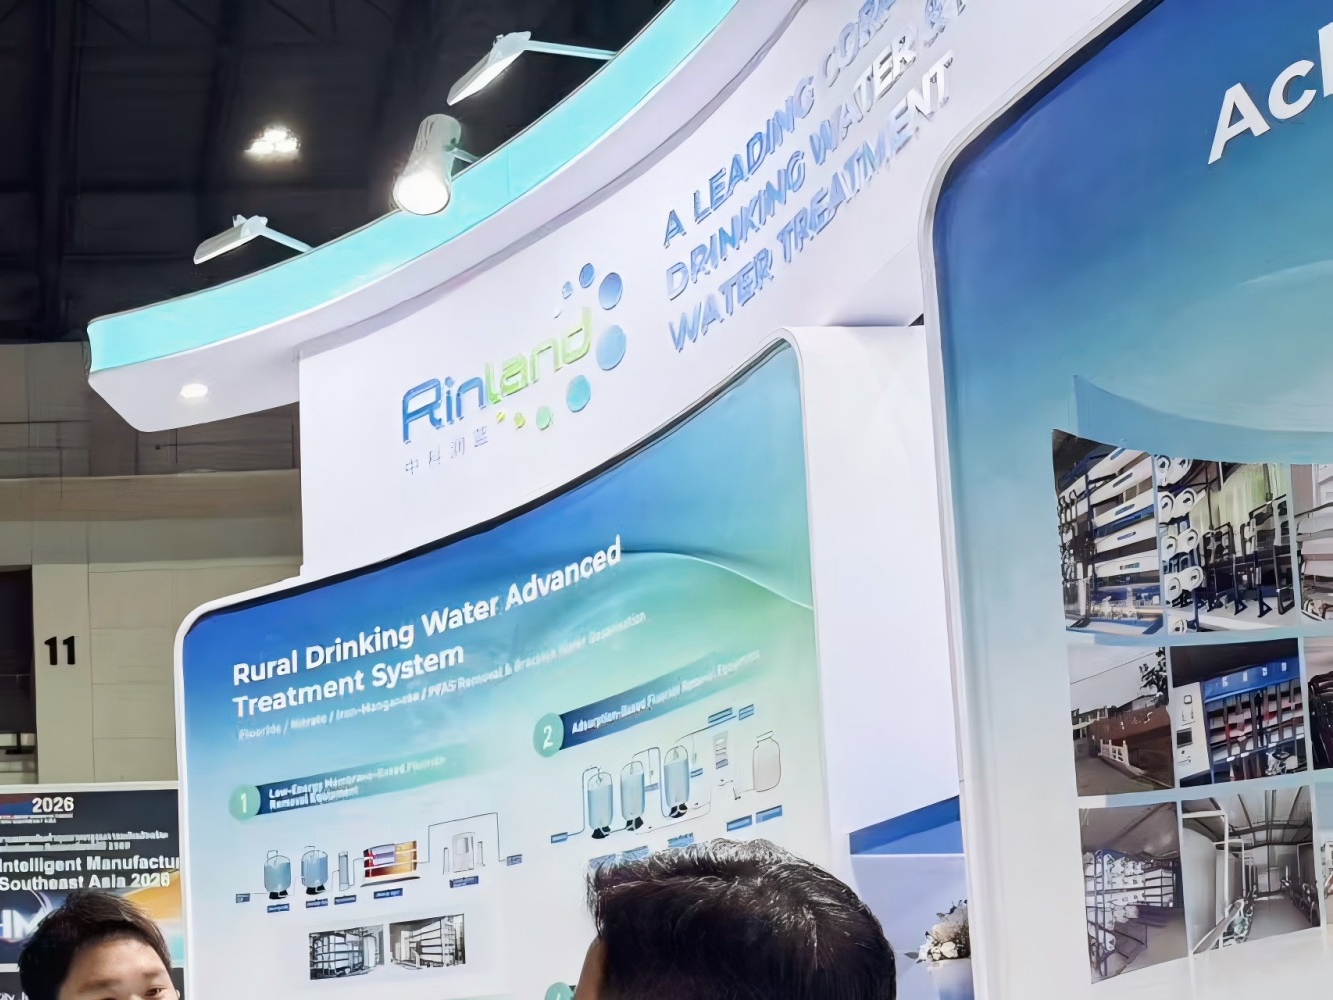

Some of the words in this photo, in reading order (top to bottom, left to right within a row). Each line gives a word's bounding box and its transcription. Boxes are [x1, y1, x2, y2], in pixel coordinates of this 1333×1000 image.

[664, 209, 687, 249] A
[693, 75, 815, 224] LEADING
[666, 150, 806, 301] DRINKING
[809, 24, 916, 167] WATER
[669, 247, 774, 353] WATER
[776, 50, 954, 264] TREATMENT
[233, 649, 298, 686] Rural
[306, 621, 415, 670] Drinking
[421, 593, 499, 637] Water
[505, 534, 622, 611] Advanced
[44, 636, 75, 665] 11
[232, 669, 365, 718] Treatment
[372, 644, 465, 689] System
[543, 725, 554, 750] 2
[32, 797, 74, 813] 2026
[240, 792, 247, 814] 1
[88, 874, 126, 889] Asia
